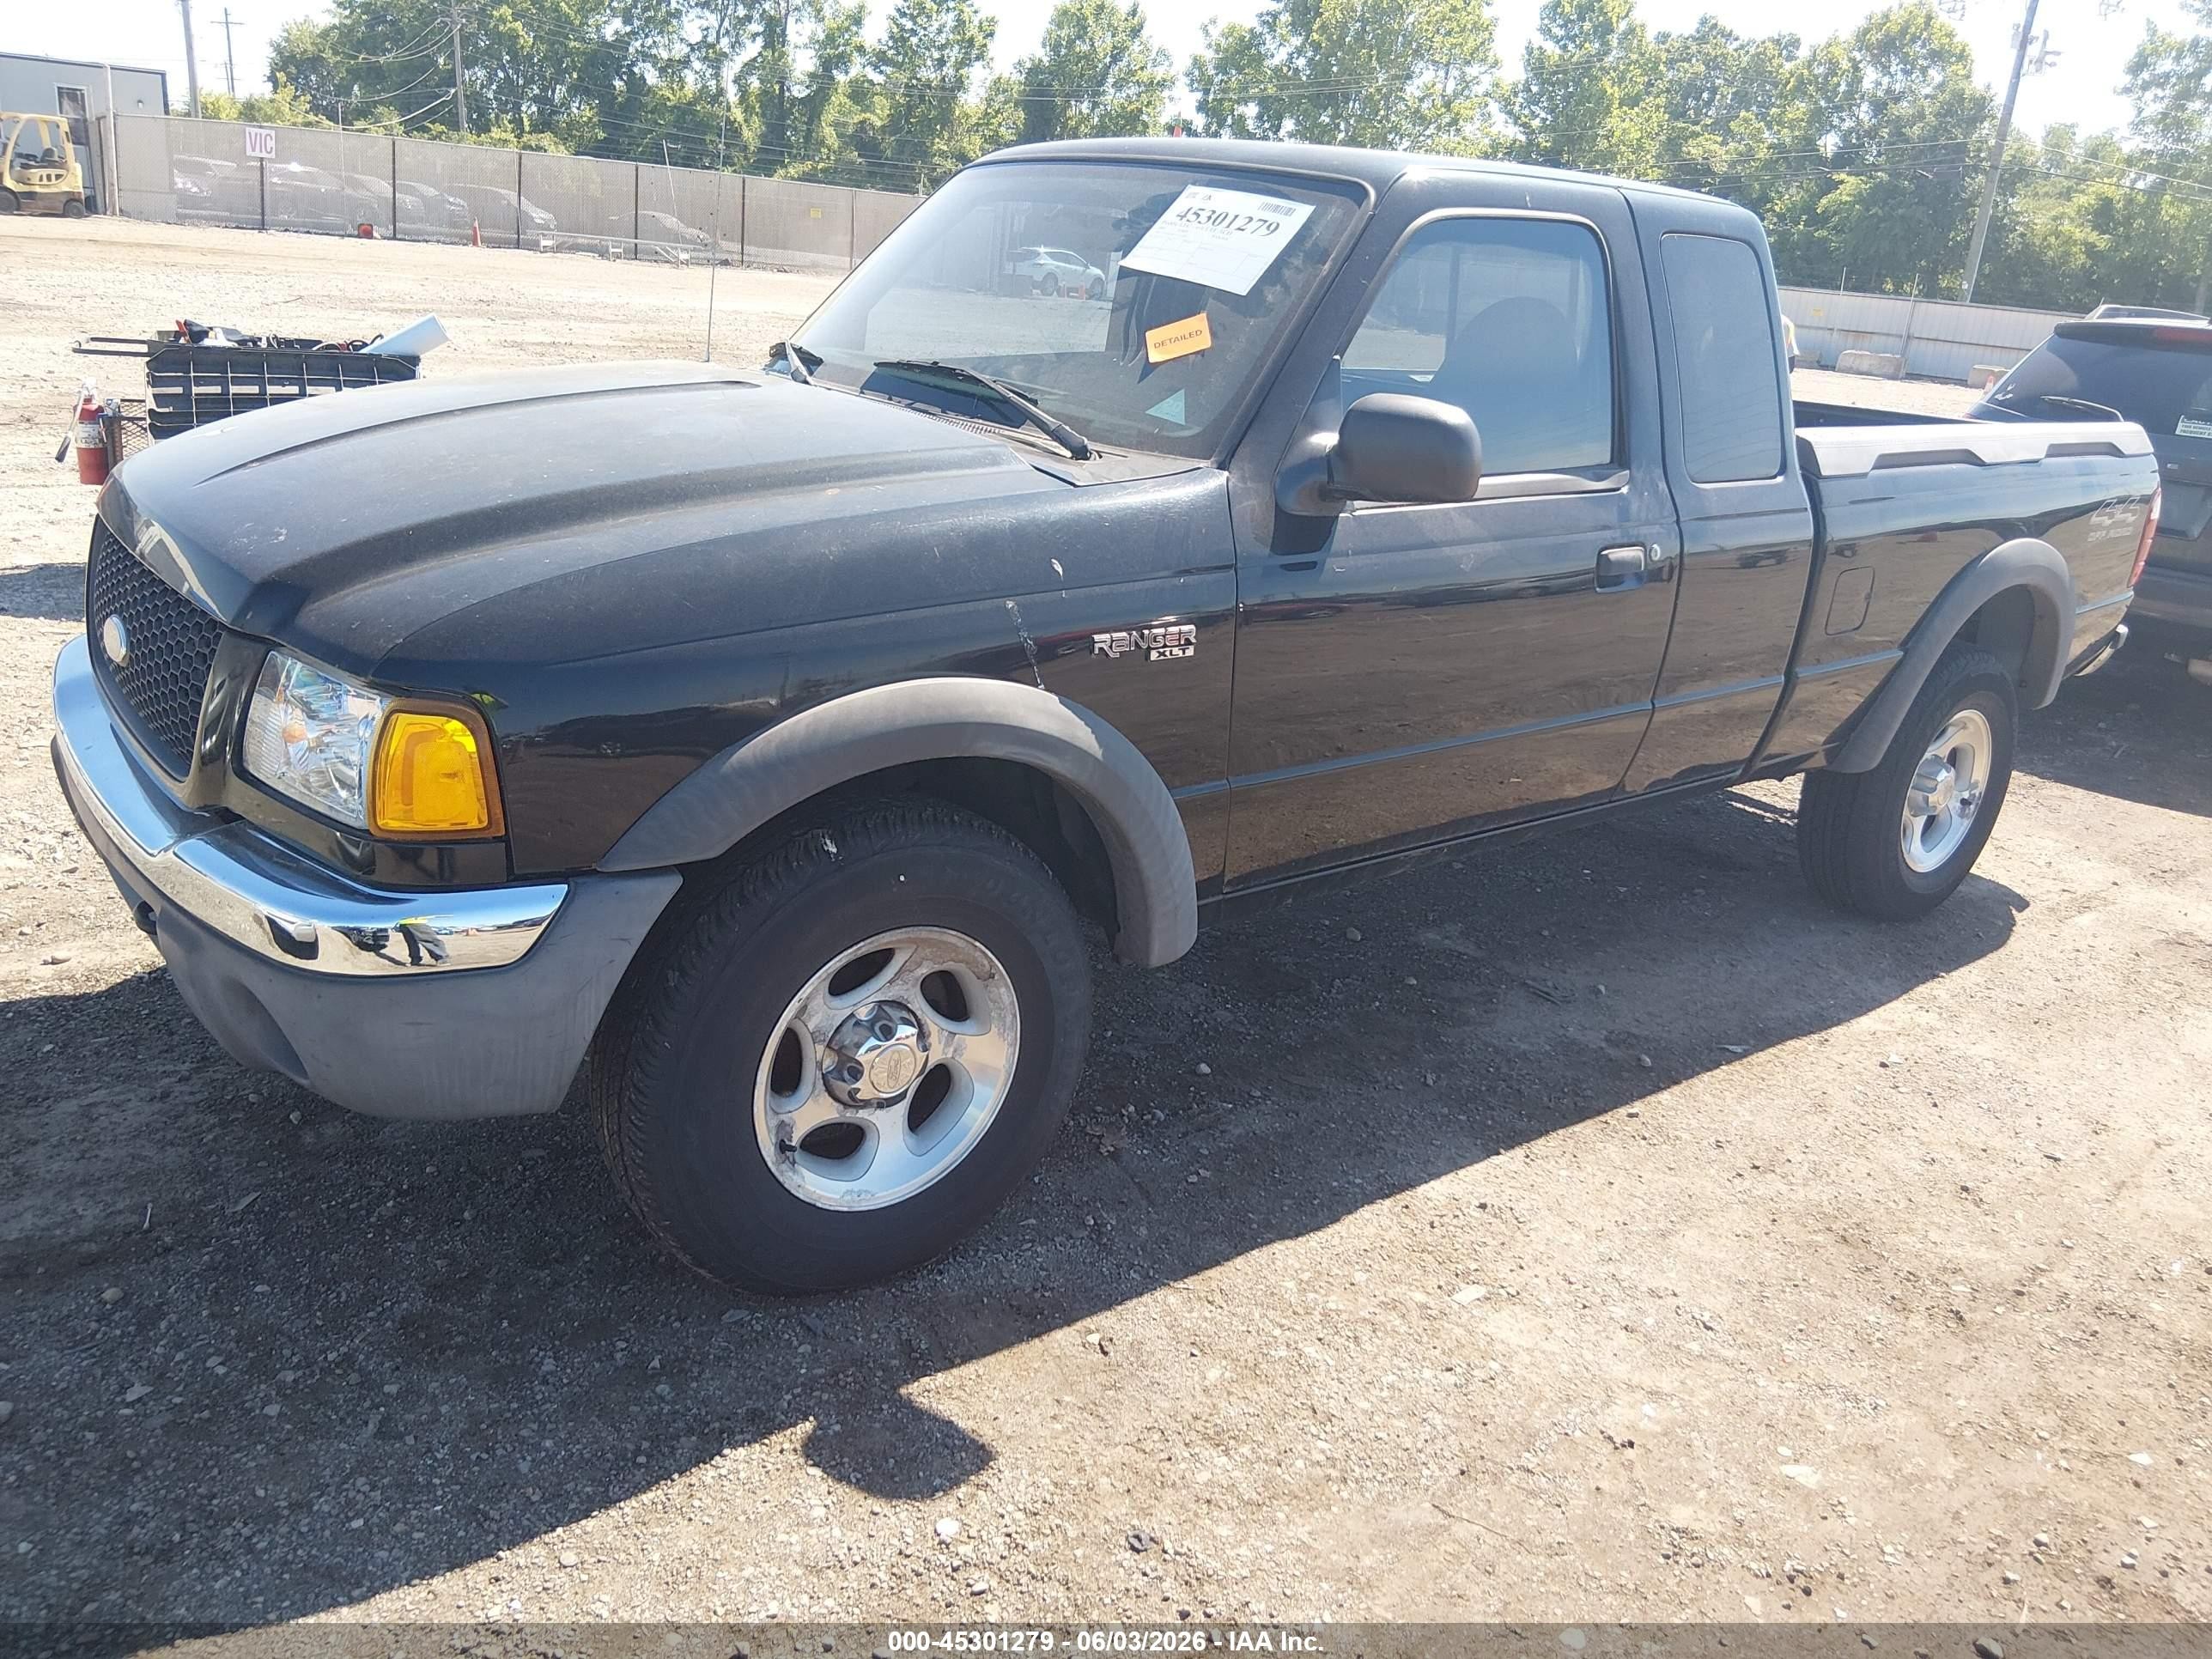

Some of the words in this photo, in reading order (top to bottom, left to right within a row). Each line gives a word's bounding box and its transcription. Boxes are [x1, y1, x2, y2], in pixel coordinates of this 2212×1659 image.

[248, 131, 273, 154] VIC
[1175, 206, 1281, 237] 45301279
[1153, 329, 1203, 349] DETAILED
[1155, 648, 1189, 659] XLT
